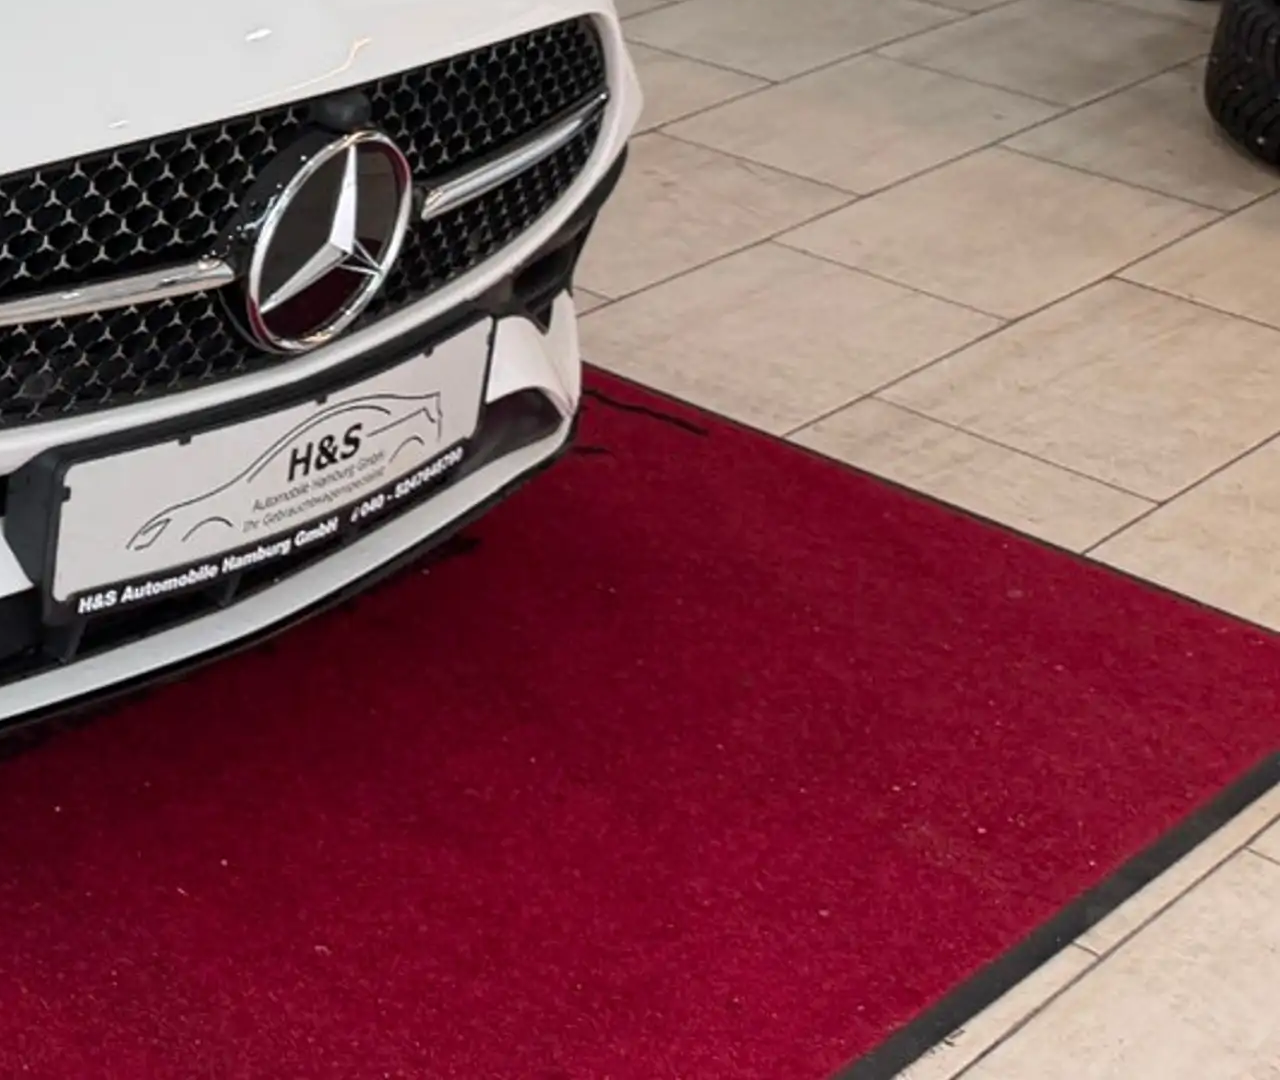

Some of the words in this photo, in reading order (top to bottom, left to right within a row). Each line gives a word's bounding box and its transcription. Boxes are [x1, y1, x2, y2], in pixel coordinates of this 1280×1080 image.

[288, 422, 363, 482] H&S
[77, 590, 118, 614] H&S
[120, 563, 219, 603] Automobile
[221, 537, 292, 573] Hamburg
[294, 516, 339, 547] GmbH
[360, 494, 386, 517] 040
